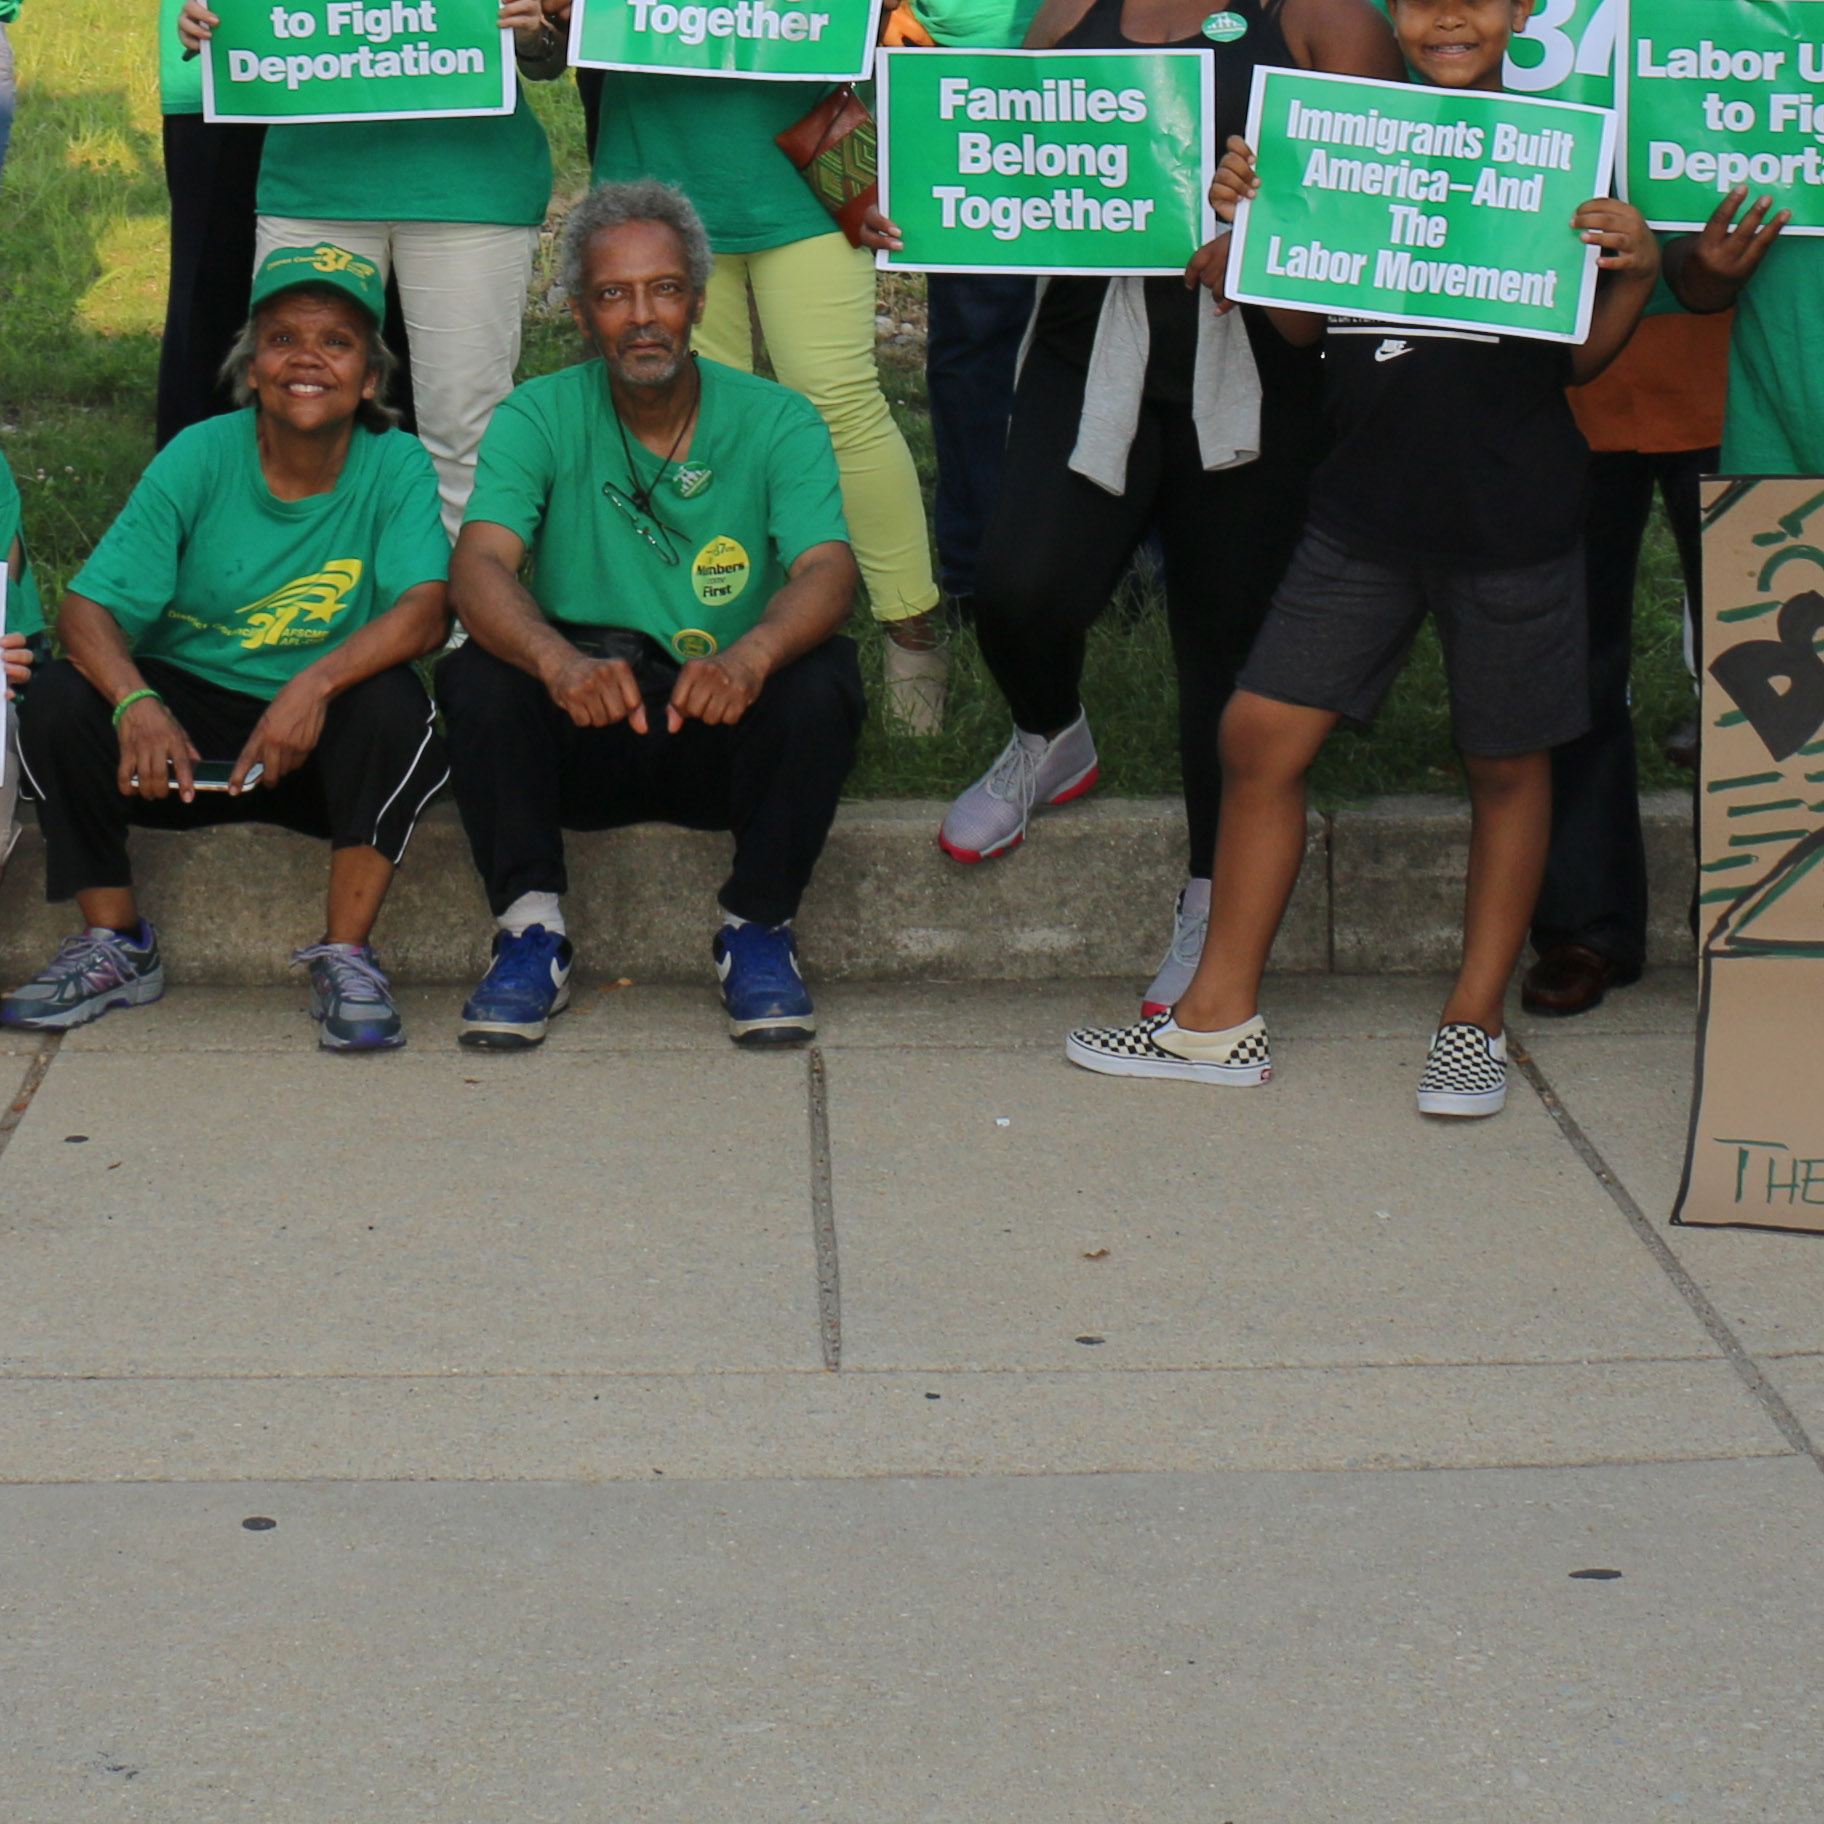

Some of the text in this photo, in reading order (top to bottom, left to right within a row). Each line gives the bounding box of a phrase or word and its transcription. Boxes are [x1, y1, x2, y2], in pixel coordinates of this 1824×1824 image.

[270, 0, 438, 44] to Fight
[228, 43, 485, 90] Deportation
[1637, 38, 1785, 81] Labor
[940, 78, 1148, 123] Families
[1702, 92, 1756, 131] to
[1286, 99, 1576, 172] Immigrants Built
[959, 132, 1129, 188] Belong
[932, 186, 1155, 241] Together
[1389, 204, 1449, 249] The
[312, 246, 353, 272] 37
[1266, 236, 1558, 309] Labor Movement
[703, 584, 732, 598] First
[240, 605, 301, 650] 37
